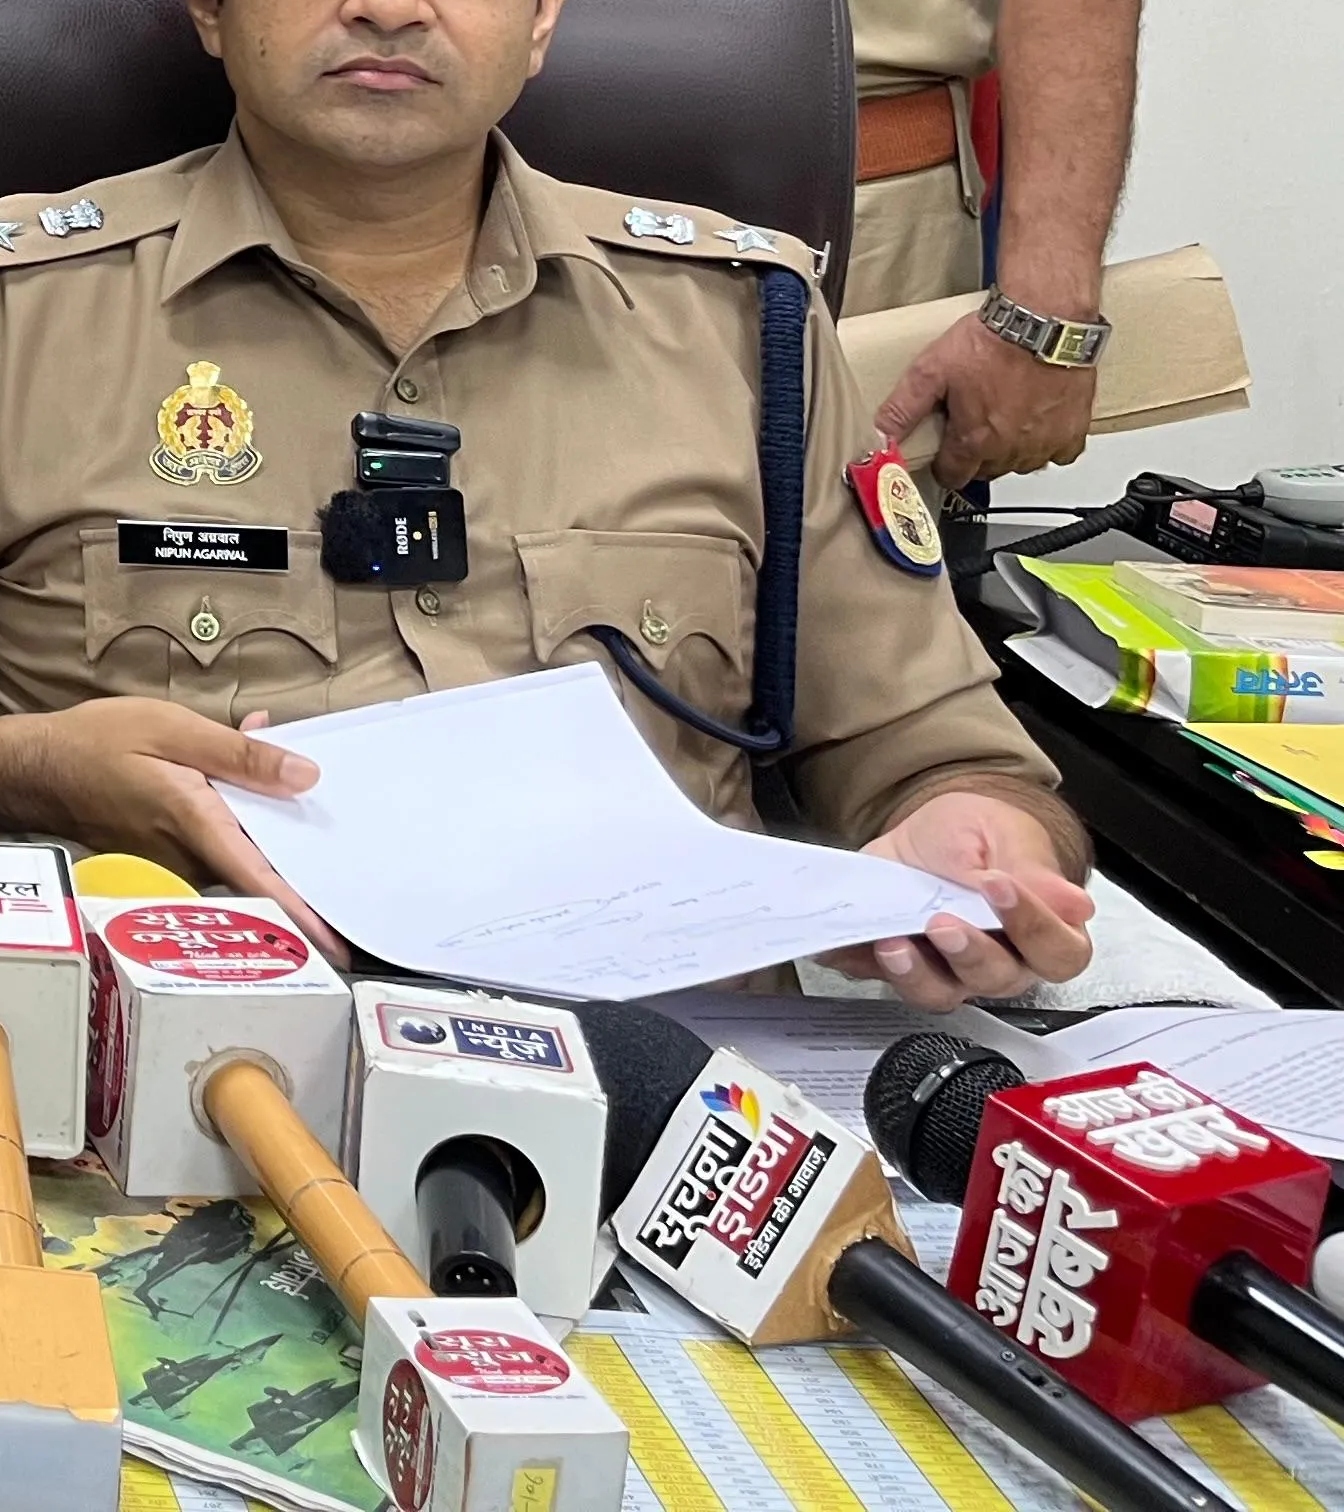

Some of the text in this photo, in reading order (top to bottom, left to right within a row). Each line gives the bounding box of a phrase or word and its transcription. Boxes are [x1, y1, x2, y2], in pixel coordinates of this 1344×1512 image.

[155, 546, 249, 563] NIPUN AGARWAL
[163, 526, 241, 547] निपुण अग्रवाल
[457, 1020, 545, 1042] INDIA
[1043, 1086, 1152, 1130] आज
[1125, 1070, 1204, 1111] की
[1086, 1103, 1271, 1172] खबर
[640, 1114, 737, 1249] सूचना
[771, 1195, 795, 1225] की
[975, 1140, 1053, 1327] आज की
[1016, 1168, 1120, 1359] खबर
